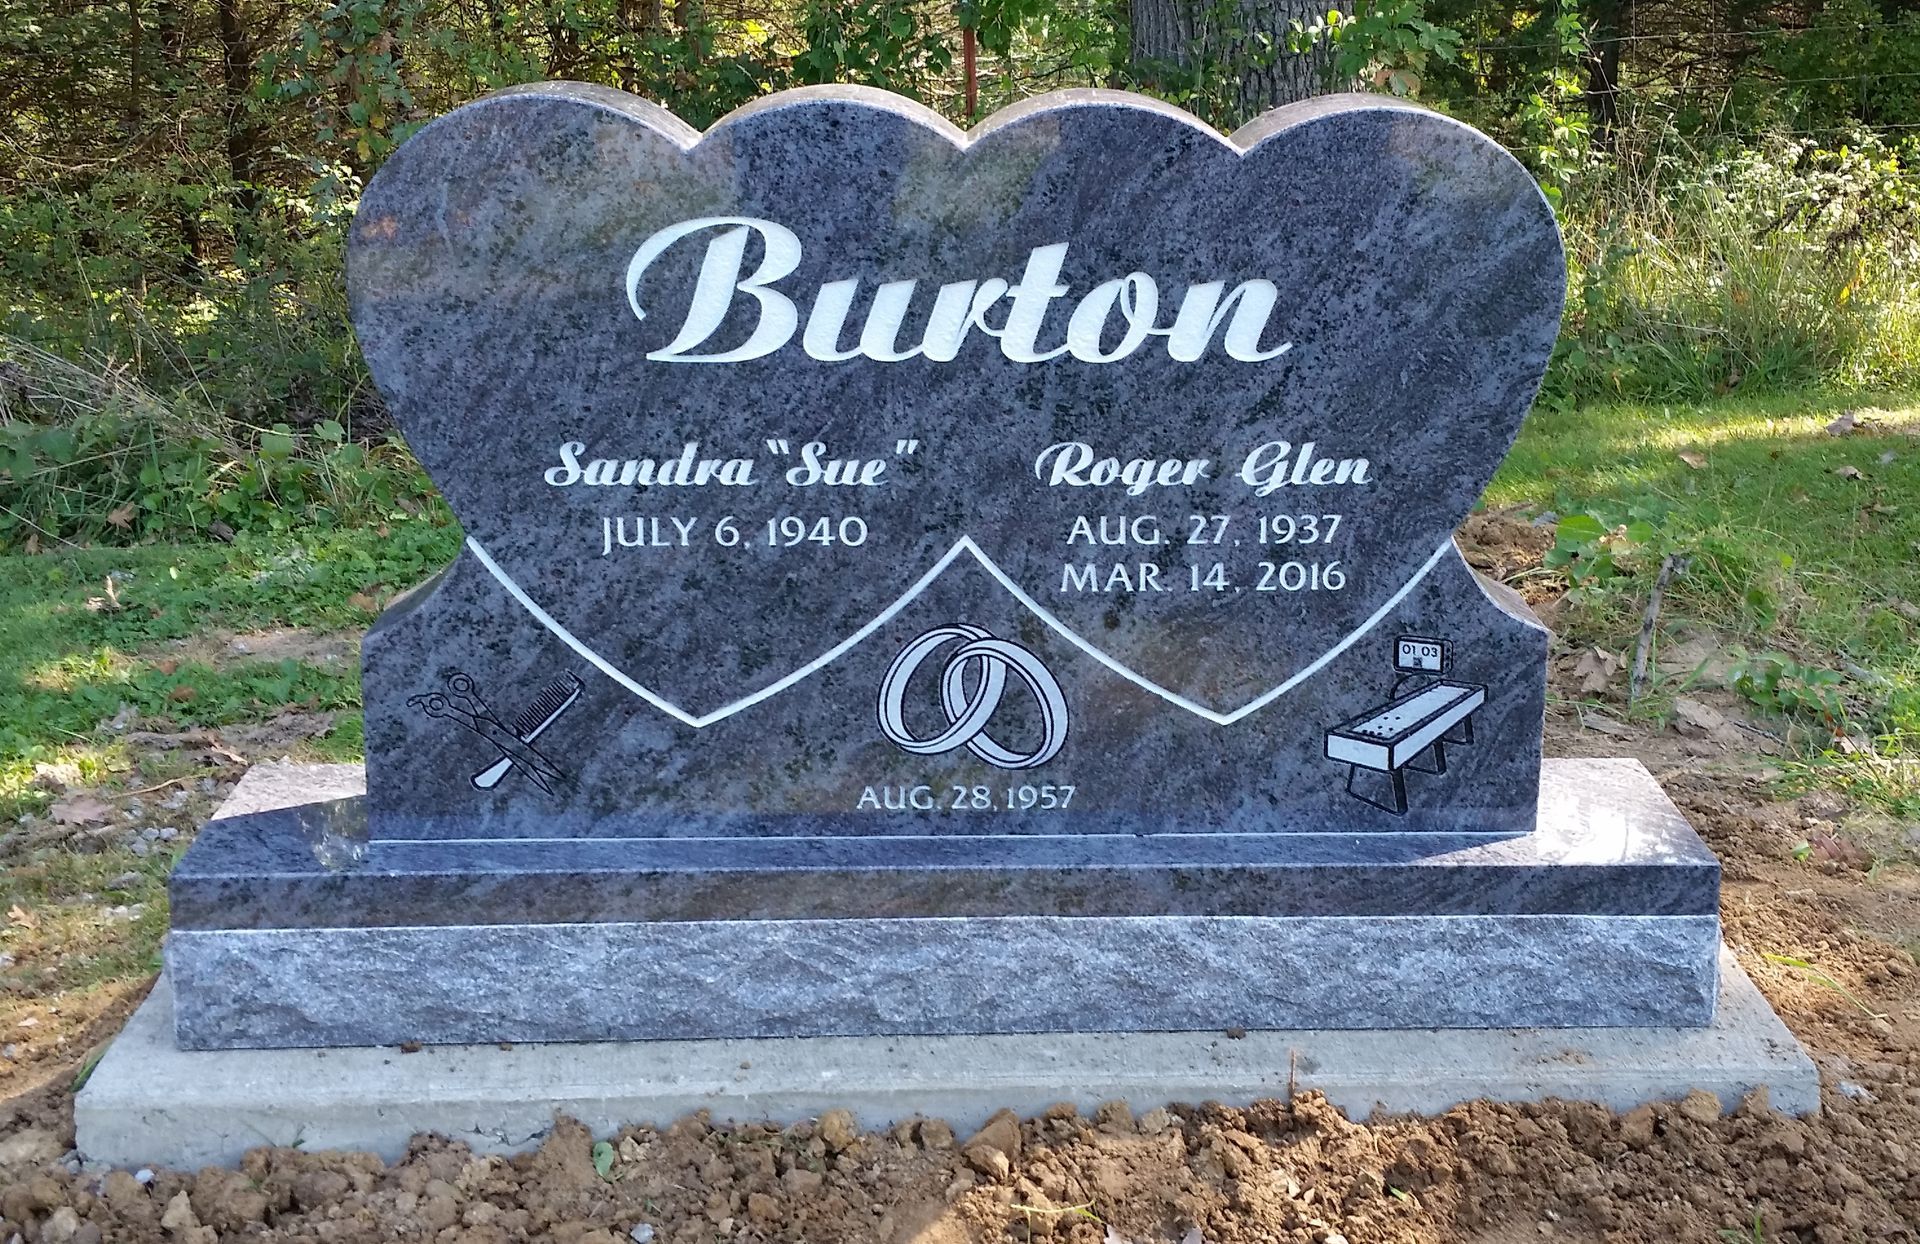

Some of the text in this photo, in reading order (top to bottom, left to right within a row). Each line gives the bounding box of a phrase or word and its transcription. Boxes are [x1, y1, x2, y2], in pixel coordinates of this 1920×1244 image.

[625, 215, 1293, 364] Burton
[543, 438, 920, 487] Sandra "Sue"
[1034, 440, 1373, 498] Roger Glen
[602, 515, 868, 556] JULY 6, 1940
[1066, 514, 1343, 548] AUG. 27, 1937
[1060, 560, 1346, 593] MAR. 14, 2016
[856, 785, 1076, 814] AUG. 28, 1957
